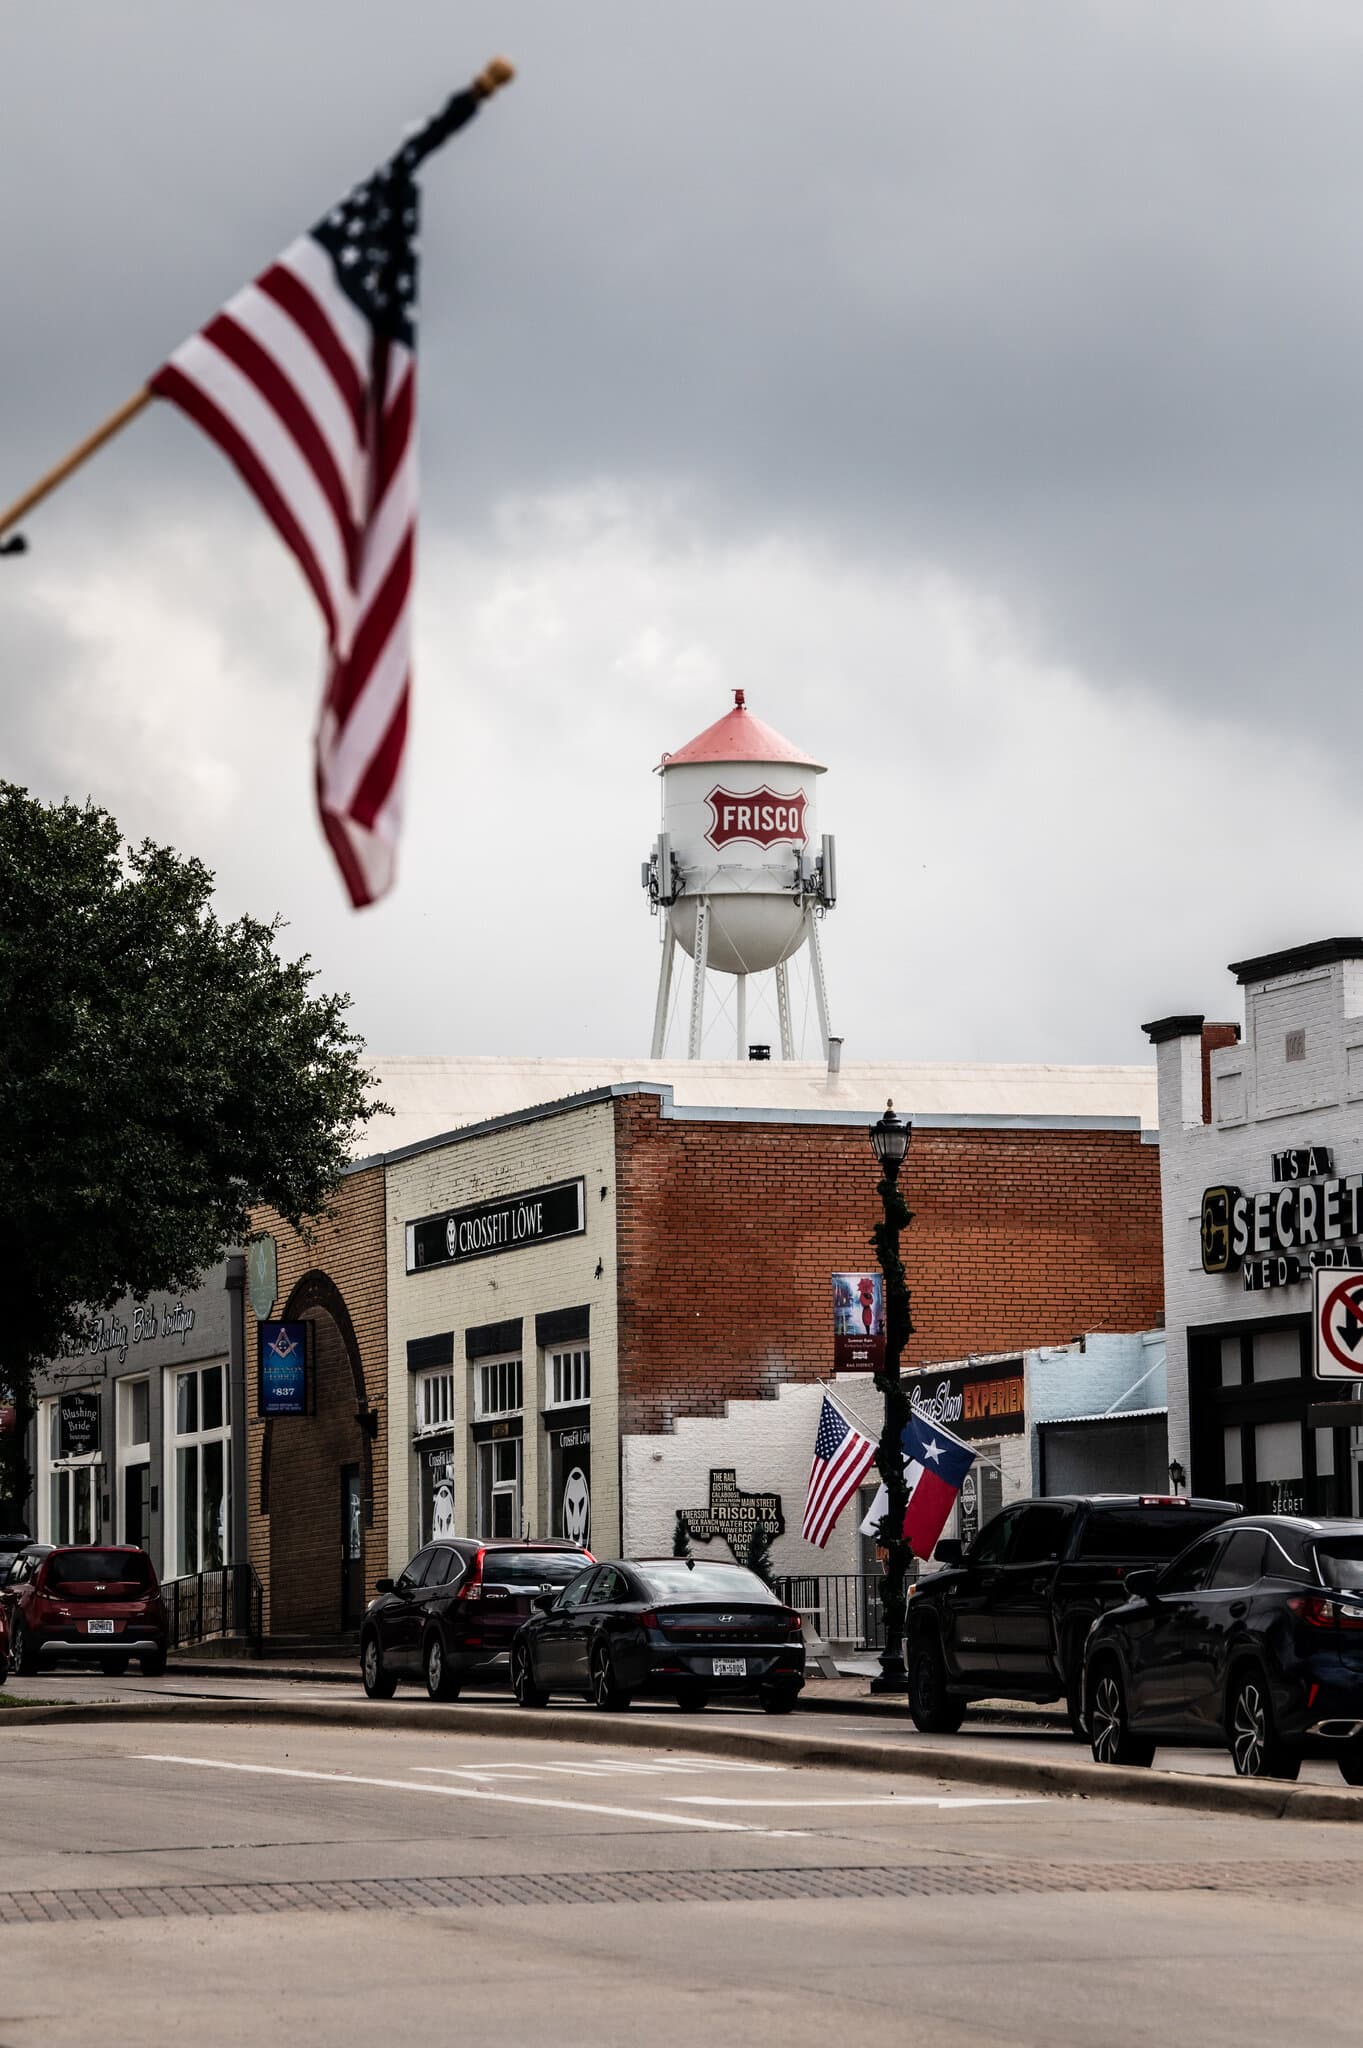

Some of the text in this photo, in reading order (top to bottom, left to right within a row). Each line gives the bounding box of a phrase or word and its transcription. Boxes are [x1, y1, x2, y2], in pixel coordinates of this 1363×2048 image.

[723, 805, 799, 833] FRISCO
[1271, 1148, 1319, 1182] IT'S A
[1232, 1174, 1363, 1256] SECRET
[459, 1201, 544, 1253] CROSSFIT LÖWE
[1243, 1256, 1289, 1291] MED
[62, 1406, 97, 1421] Blushing
[68, 1420, 91, 1431] Bride
[713, 1472, 736, 1482] THE RAIL
[712, 1482, 736, 1491] DISTRICT
[741, 1498, 756, 1507] MAIN
[756, 1498, 777, 1507] STREET
[1272, 1498, 1304, 1513] SECRET
[690, 1525, 720, 1533] COTTON
[719, 1520, 743, 1528] WATER
